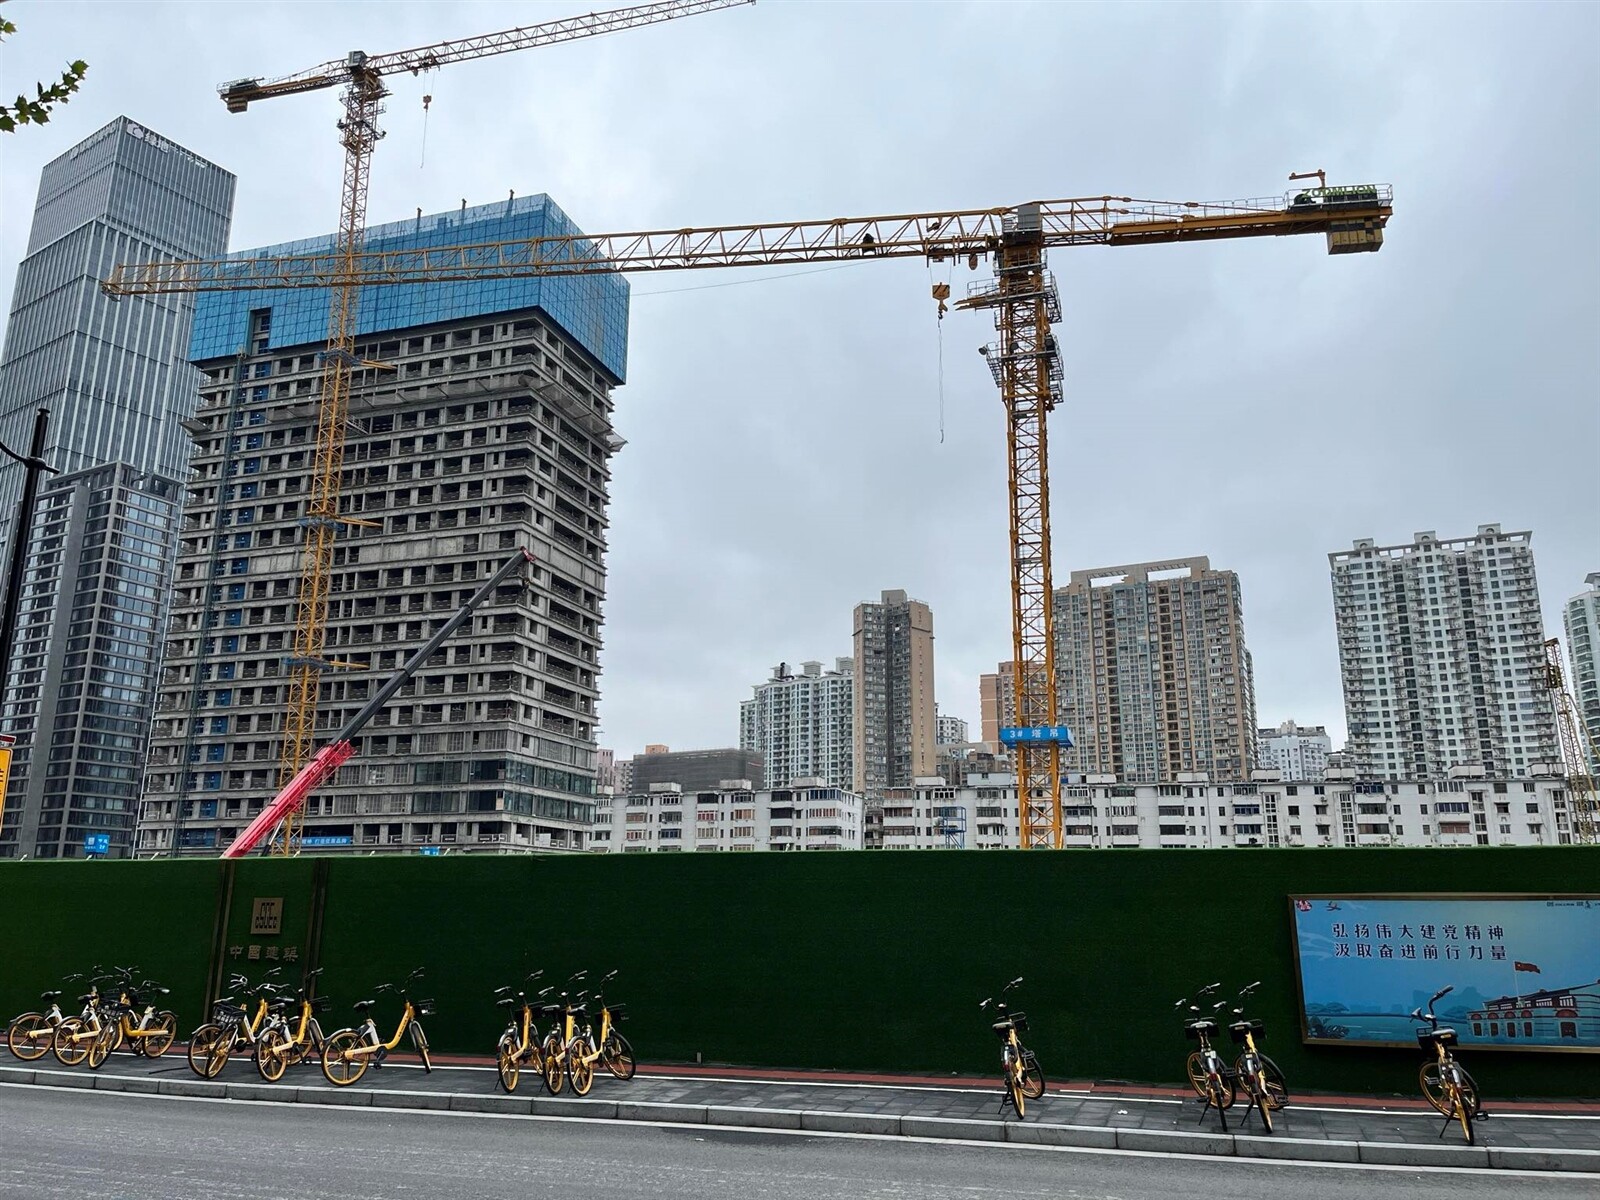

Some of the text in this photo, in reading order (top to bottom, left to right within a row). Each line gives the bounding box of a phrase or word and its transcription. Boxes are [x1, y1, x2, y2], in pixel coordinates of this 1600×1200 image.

[1301, 185, 1376, 198] ZOOMLION
[1332, 923, 1504, 941] 弘扬伟大建党精神
[1334, 943, 1507, 961] 汲取奋进前行力量
